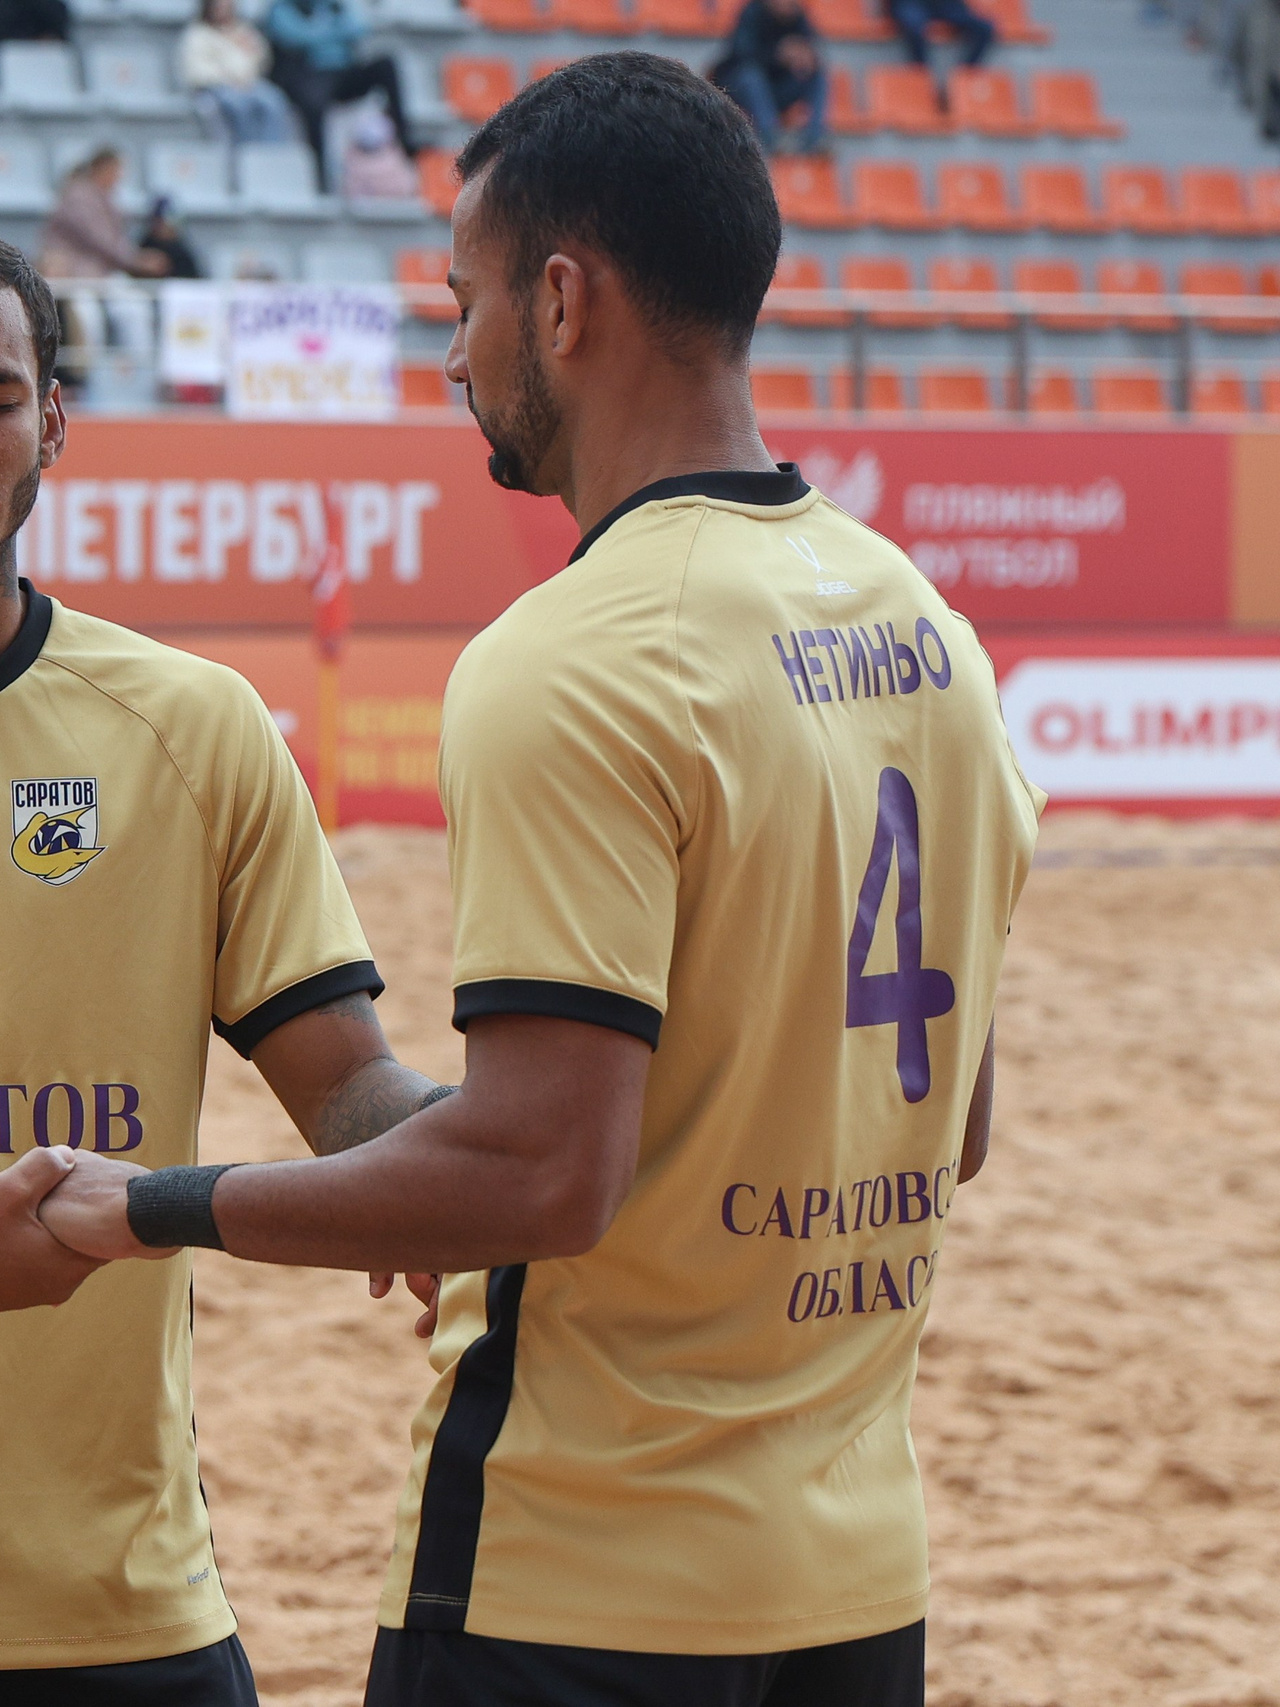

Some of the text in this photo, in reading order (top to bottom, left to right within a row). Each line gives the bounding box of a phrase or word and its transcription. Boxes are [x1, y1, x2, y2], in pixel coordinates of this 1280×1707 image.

[772, 617, 952, 705] НЕТИНЬО
[1028, 703, 1280, 758] OLIMP
[15, 781, 94, 808] САРАТОВ
[845, 766, 955, 1103] 4
[721, 1158, 958, 1239] САРАТОВС
